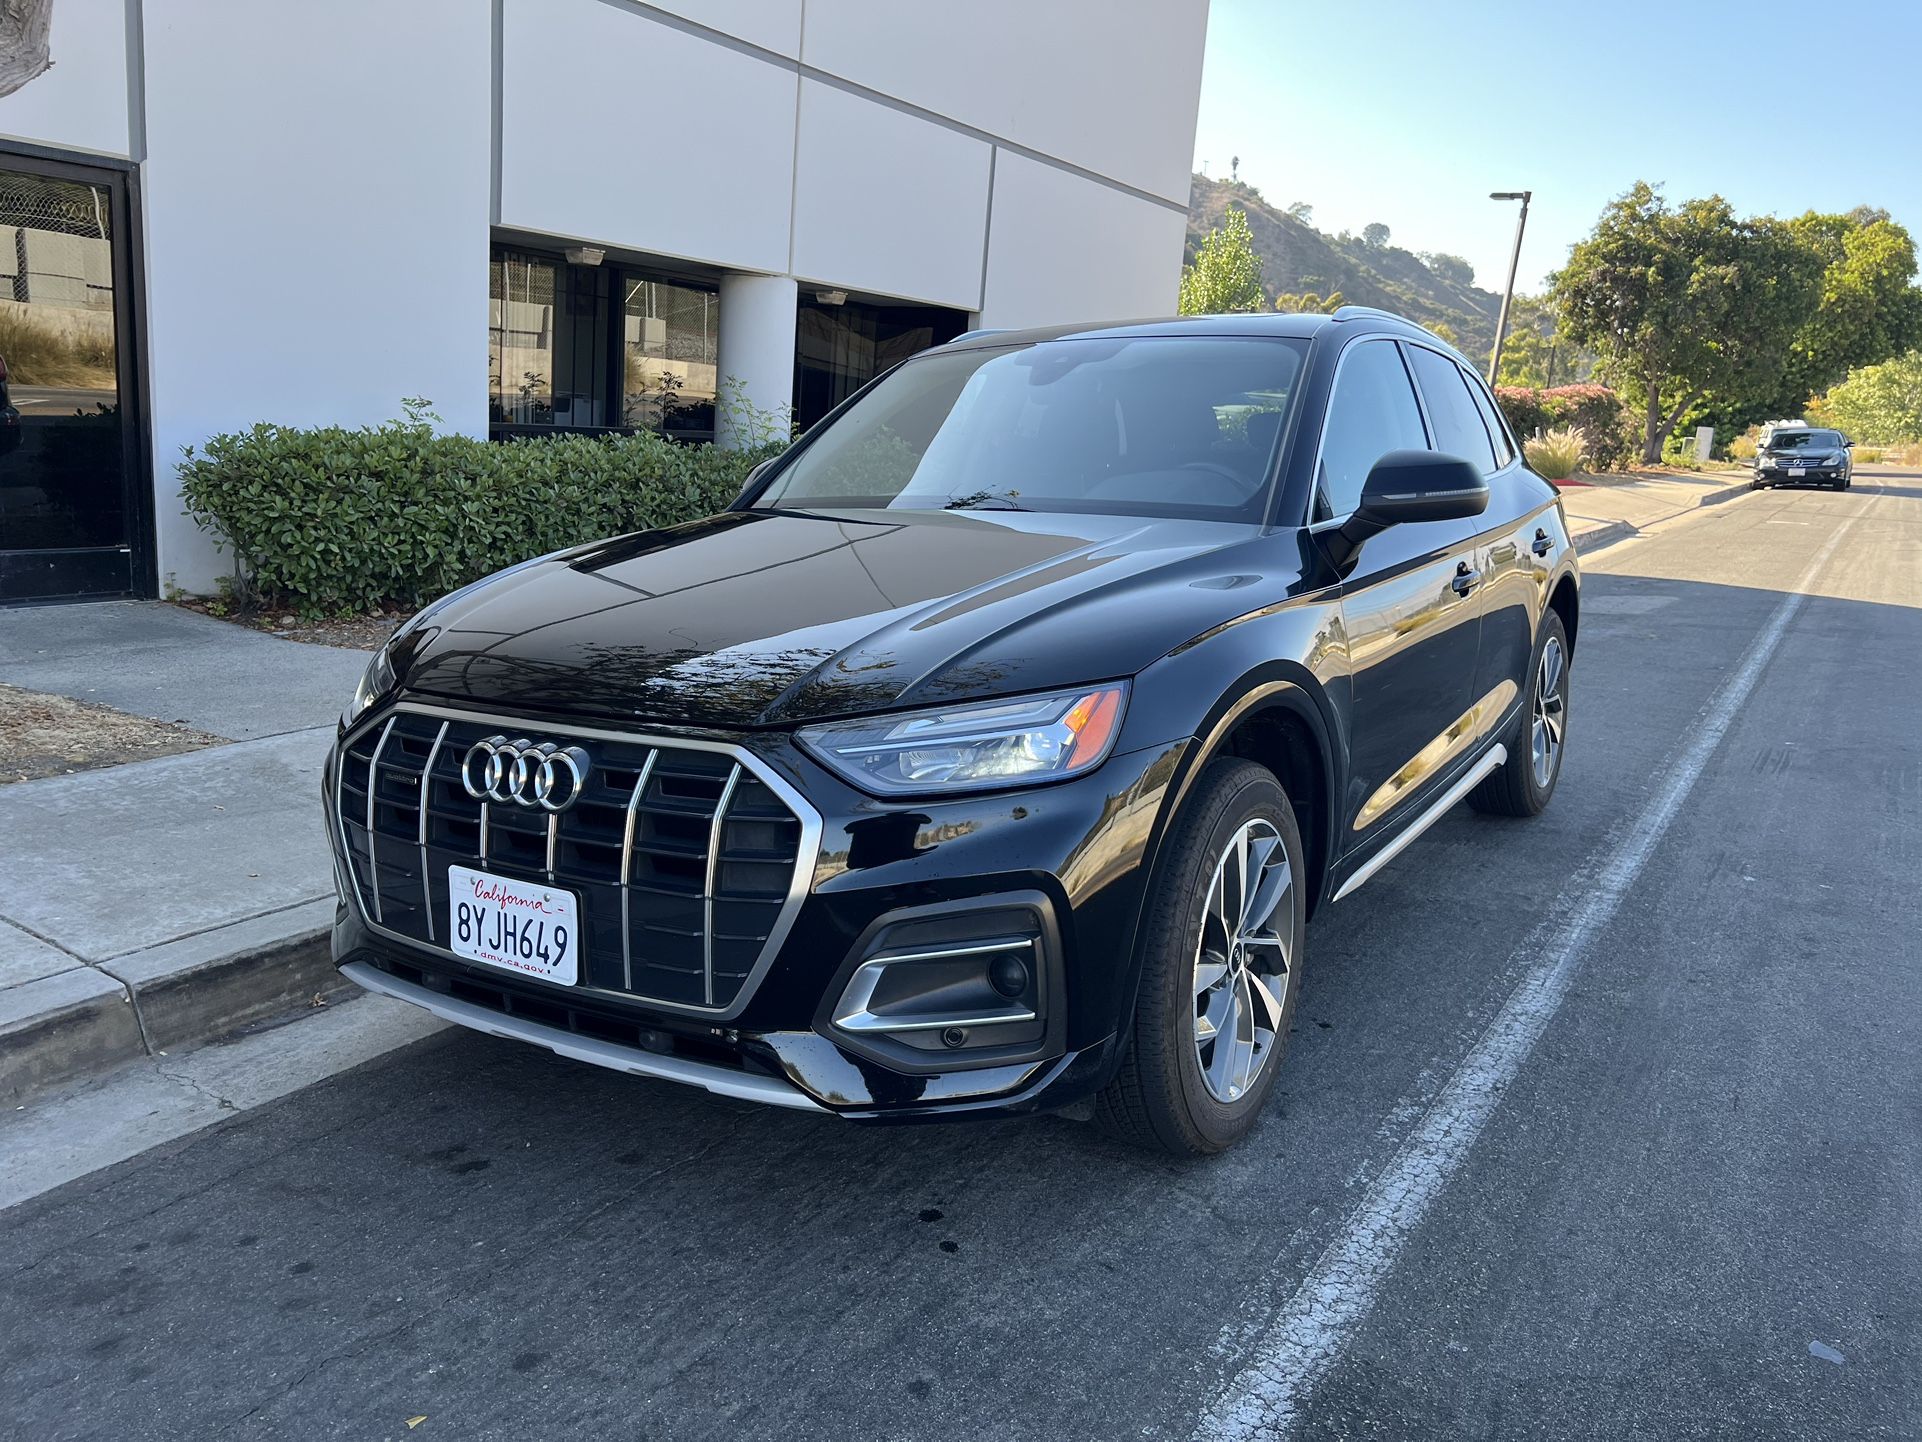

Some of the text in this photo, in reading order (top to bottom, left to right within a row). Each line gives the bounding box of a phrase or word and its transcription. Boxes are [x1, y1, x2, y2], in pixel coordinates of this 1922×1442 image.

[474, 879, 552, 914] California
[457, 902, 568, 967] 8YJH649
[480, 951, 544, 974] dmv.ca.gov
